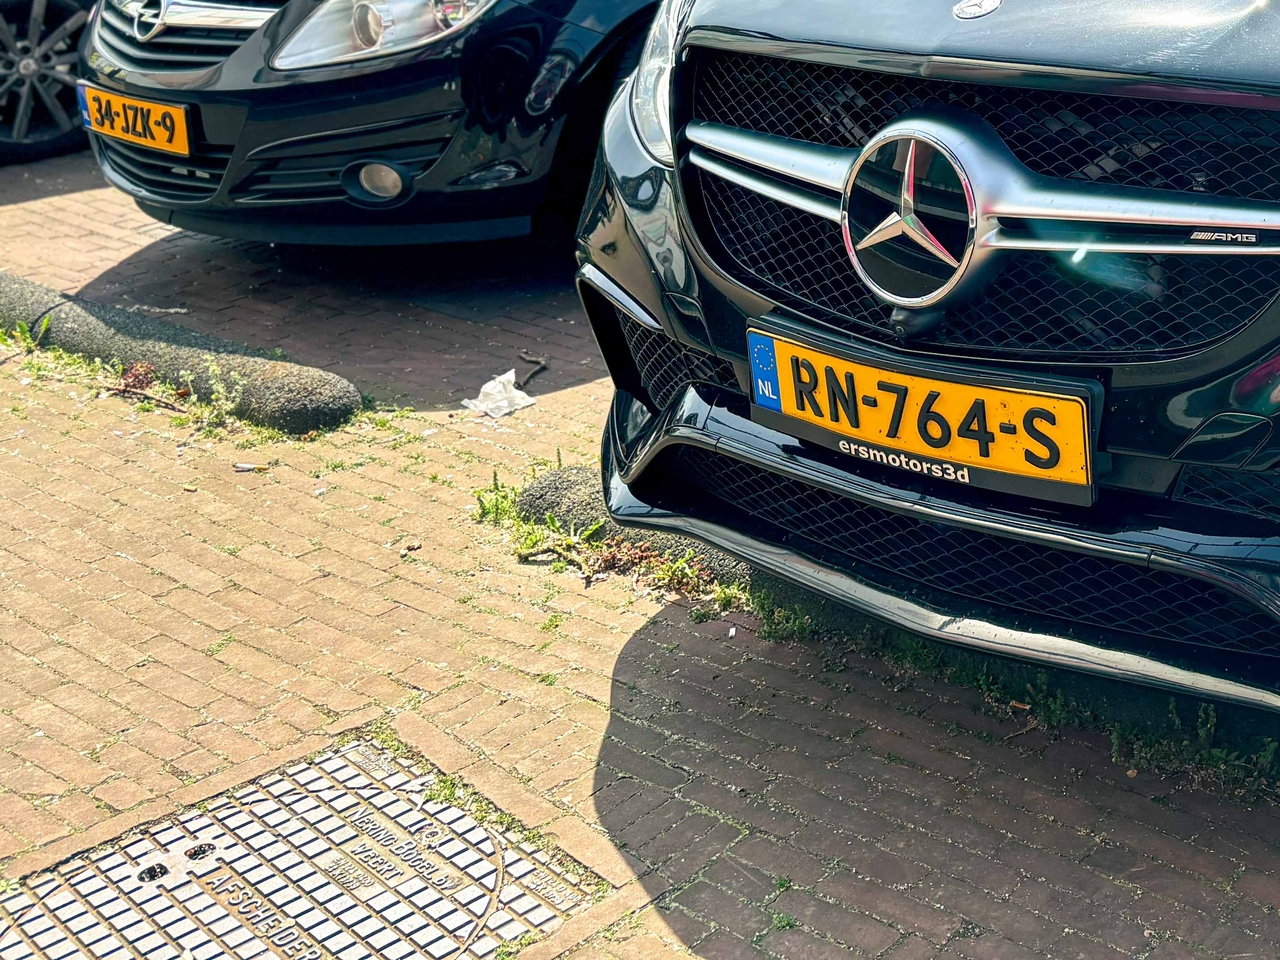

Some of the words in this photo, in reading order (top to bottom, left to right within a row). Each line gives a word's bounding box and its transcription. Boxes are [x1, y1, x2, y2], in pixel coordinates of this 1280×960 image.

[92, 94, 175, 144] 34-JZK-9
[1210, 232, 1256, 243] AMG
[757, 378, 778, 400] NL
[789, 355, 1061, 470] RN-764-S
[838, 440, 971, 484] ersmotors3d
[351, 843, 404, 881] WEERT
